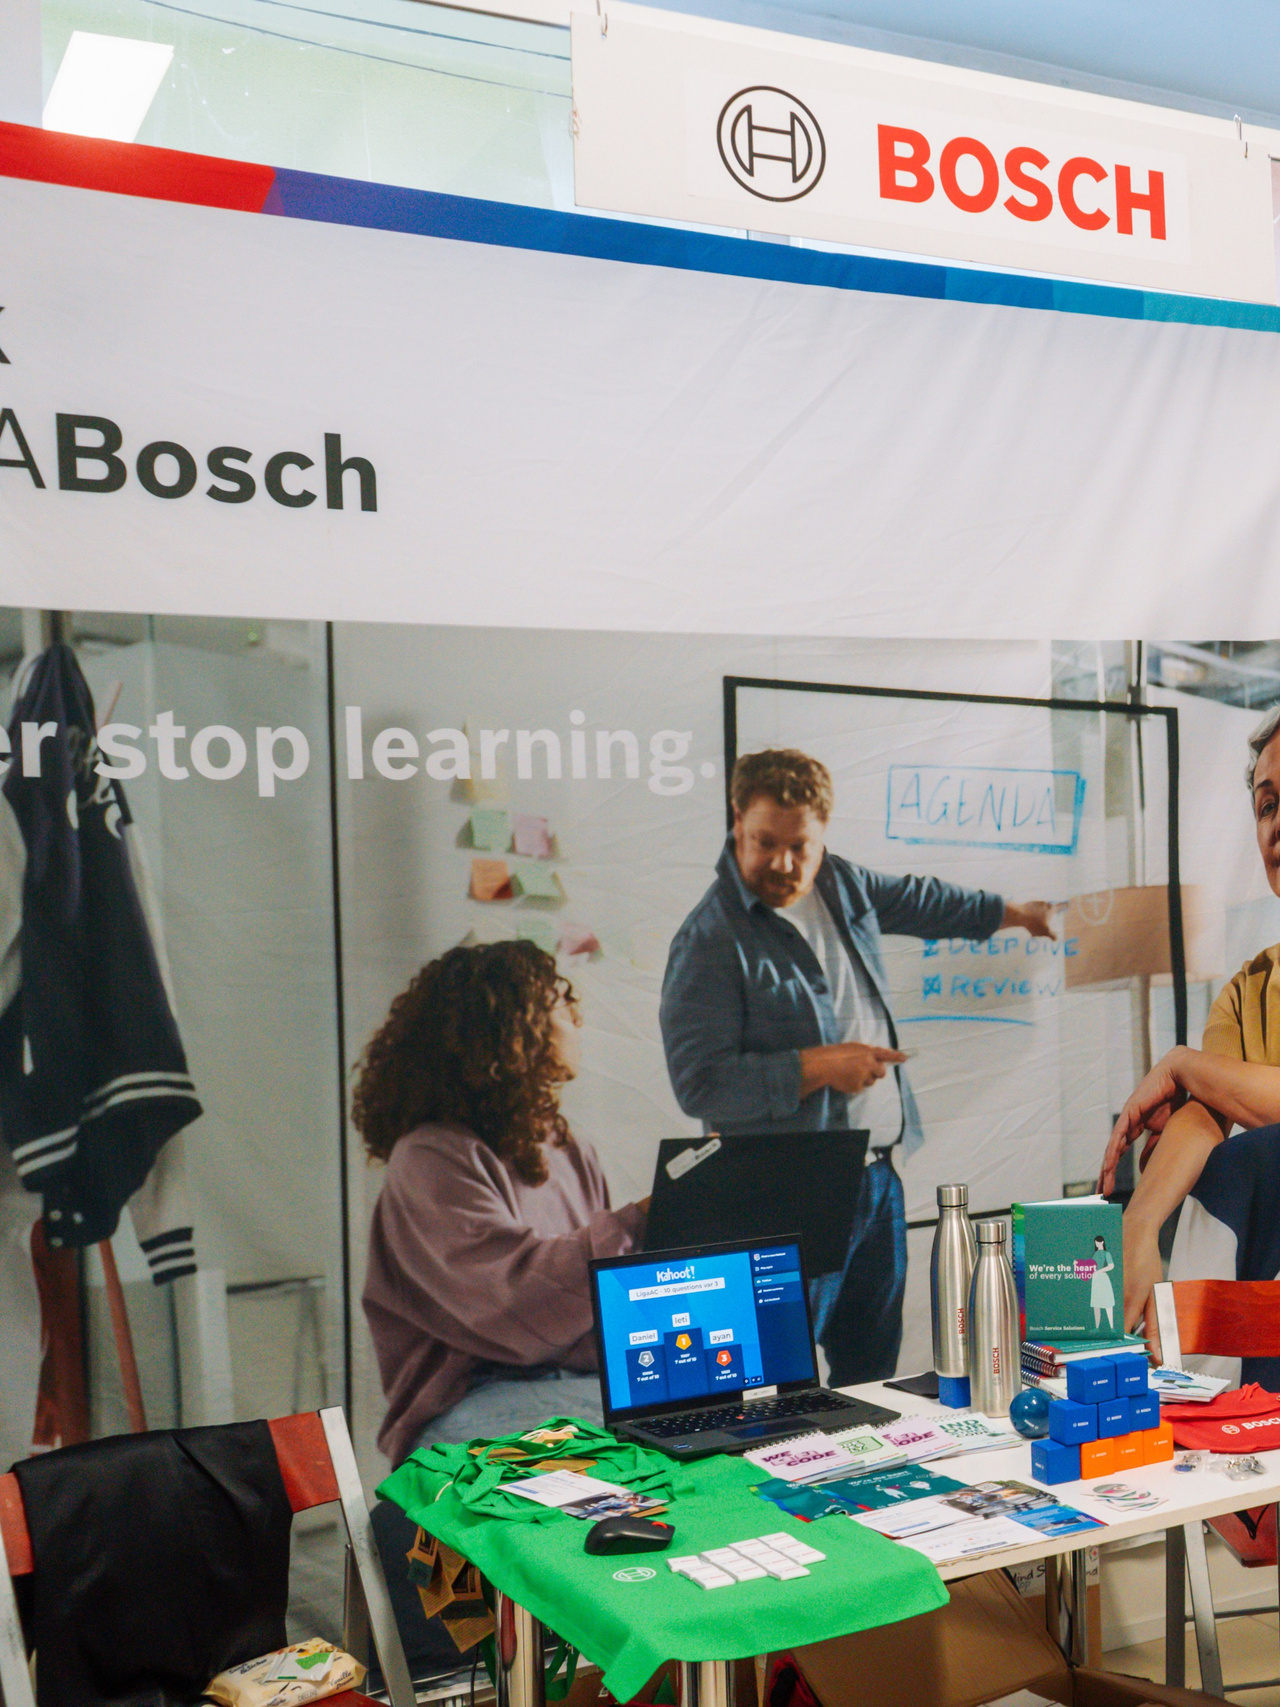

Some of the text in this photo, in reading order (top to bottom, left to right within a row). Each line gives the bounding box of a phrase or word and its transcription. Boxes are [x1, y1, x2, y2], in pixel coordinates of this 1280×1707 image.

[877, 123, 1167, 241] BOSCH
[94, 710, 311, 797] stop
[345, 706, 717, 796] learning.
[900, 773, 1056, 834] AGENDA
[656, 1265, 695, 1282] Kahoot!
[1029, 1264, 1097, 1272] We're the heart
[1029, 1272, 1038, 1280] of
[1040, 1273, 1062, 1281] every
[672, 1283, 703, 1293] questions
[674, 1315, 688, 1324] leti
[957, 1307, 965, 1335] BOSCH
[632, 1332, 656, 1342] Daniel
[712, 1333, 731, 1342] ayan
[992, 1347, 1000, 1375] BOSCH
[762, 1451, 791, 1463] WE
[787, 1450, 837, 1467] CODE
